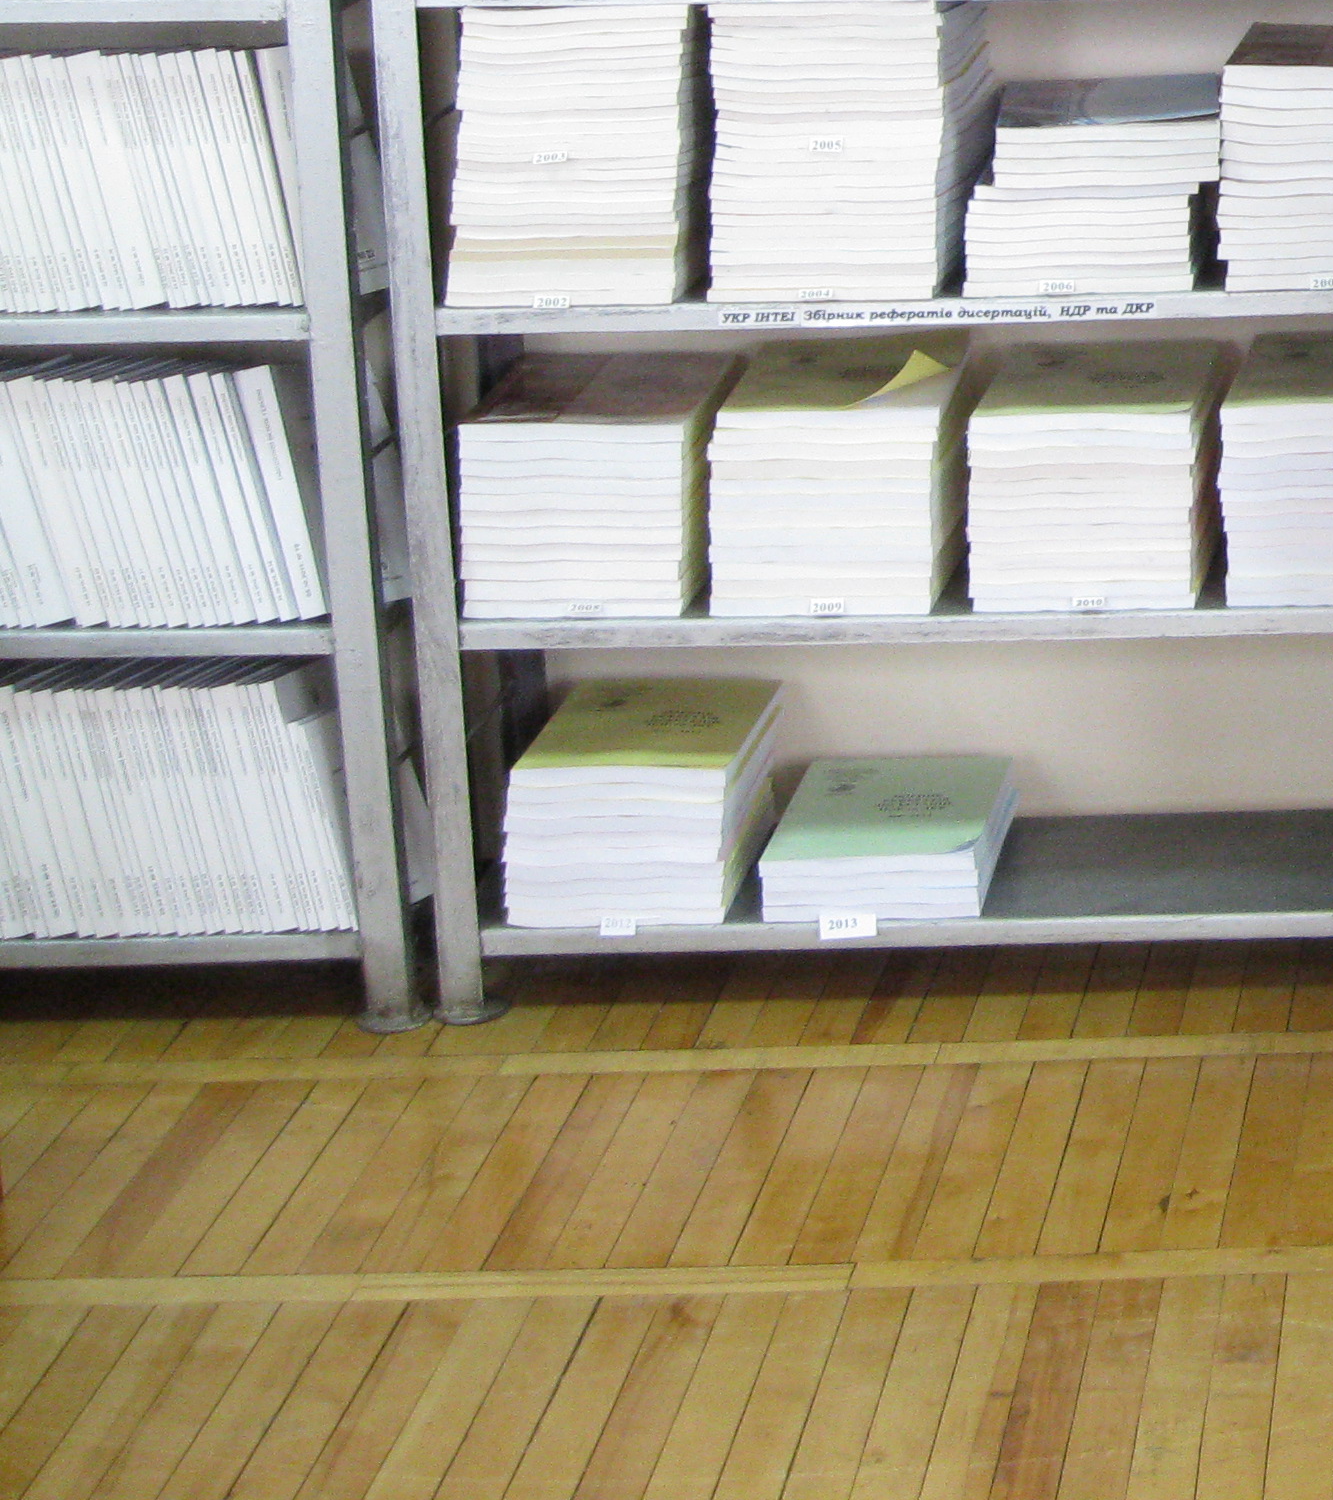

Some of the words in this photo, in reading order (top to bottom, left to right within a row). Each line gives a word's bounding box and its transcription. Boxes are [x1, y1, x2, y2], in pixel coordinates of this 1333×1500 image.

[811, 140, 842, 151] 2005
[1042, 281, 1074, 292] 2006
[536, 297, 568, 308] 2002
[721, 311, 749, 324] УКР
[754, 311, 795, 323] ІНТЕІ
[803, 309, 866, 323] Збірник
[869, 307, 952, 323] рефератів
[957, 304, 1051, 321] дисертацій,
[1059, 305, 1092, 318] НДР
[1096, 305, 1118, 315] та
[1122, 302, 1155, 316] ДКР
[812, 601, 843, 613] 2009
[1076, 598, 1104, 607] 2010
[604, 918, 632, 929] 2012
[828, 918, 858, 930] 2013
